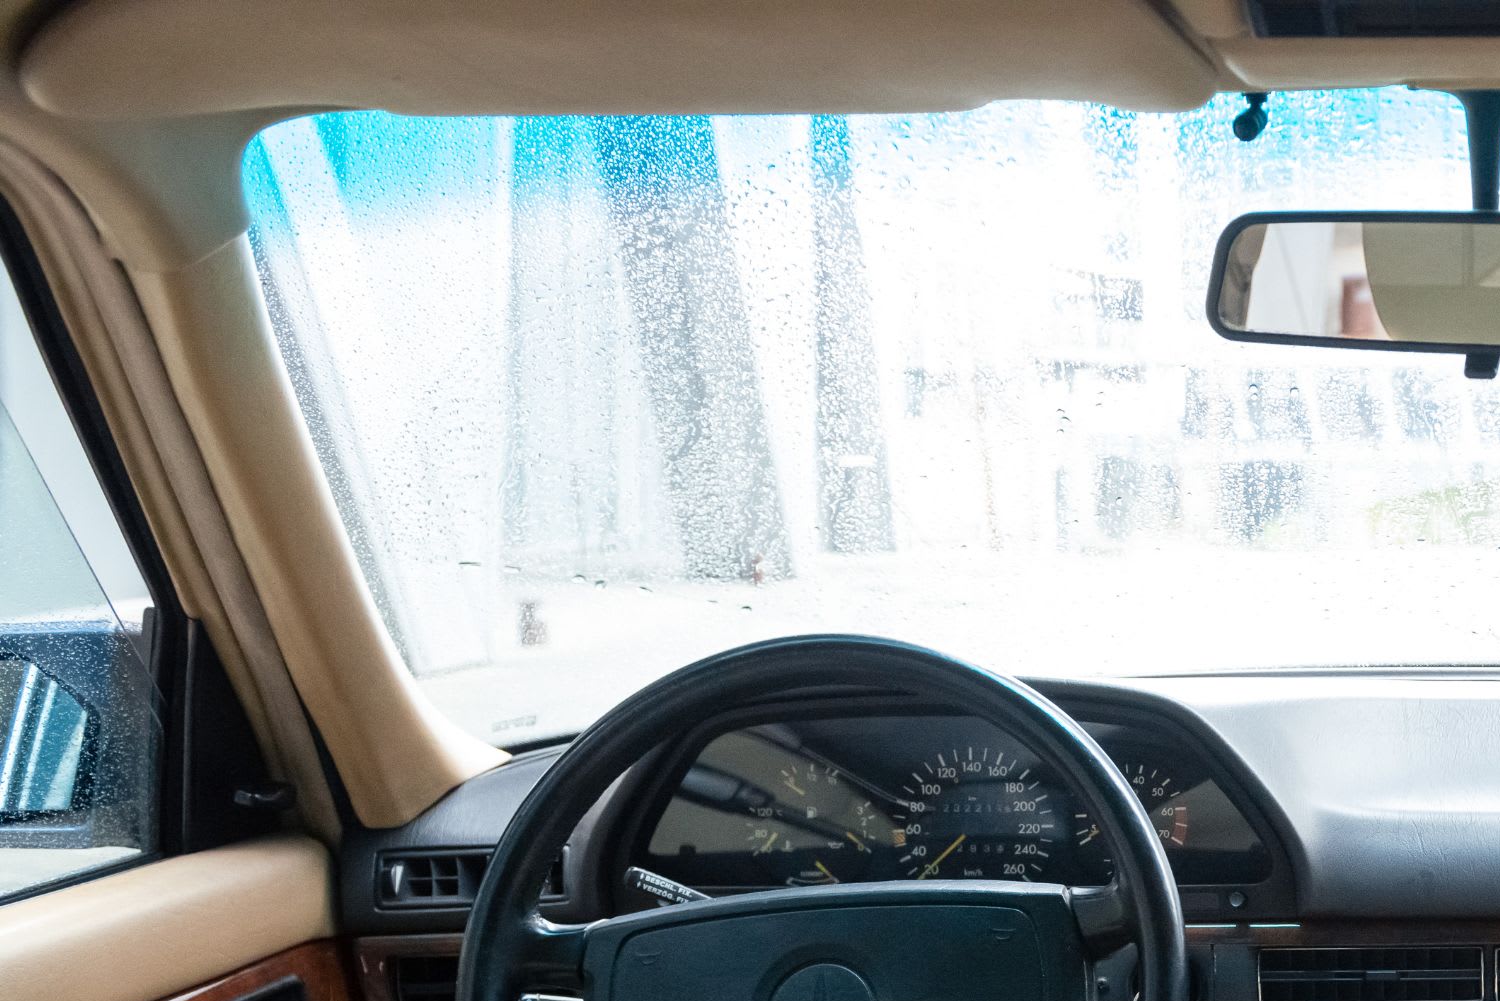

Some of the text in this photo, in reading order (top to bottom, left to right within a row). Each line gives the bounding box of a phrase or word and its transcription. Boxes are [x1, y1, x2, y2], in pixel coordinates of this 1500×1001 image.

[961, 761, 982, 772] 140
[988, 766, 1008, 777] 160
[937, 767, 957, 778] 120
[1132, 776, 1145, 785] 40
[920, 784, 941, 795] 100
[1005, 782, 1024, 793] 180
[1152, 787, 1164, 797] 50
[757, 807, 773, 817] 120
[909, 802, 925, 813] 80
[1013, 801, 1036, 812] 200
[1161, 807, 1174, 817] 60
[905, 823, 921, 834] 60
[1018, 823, 1041, 834] 220
[1159, 829, 1170, 839] 70
[911, 845, 927, 856] 40
[1014, 844, 1037, 855] 240
[924, 864, 939, 875] 20
[1003, 863, 1025, 874] 260
[644, 874, 677, 892] BESCHL.
